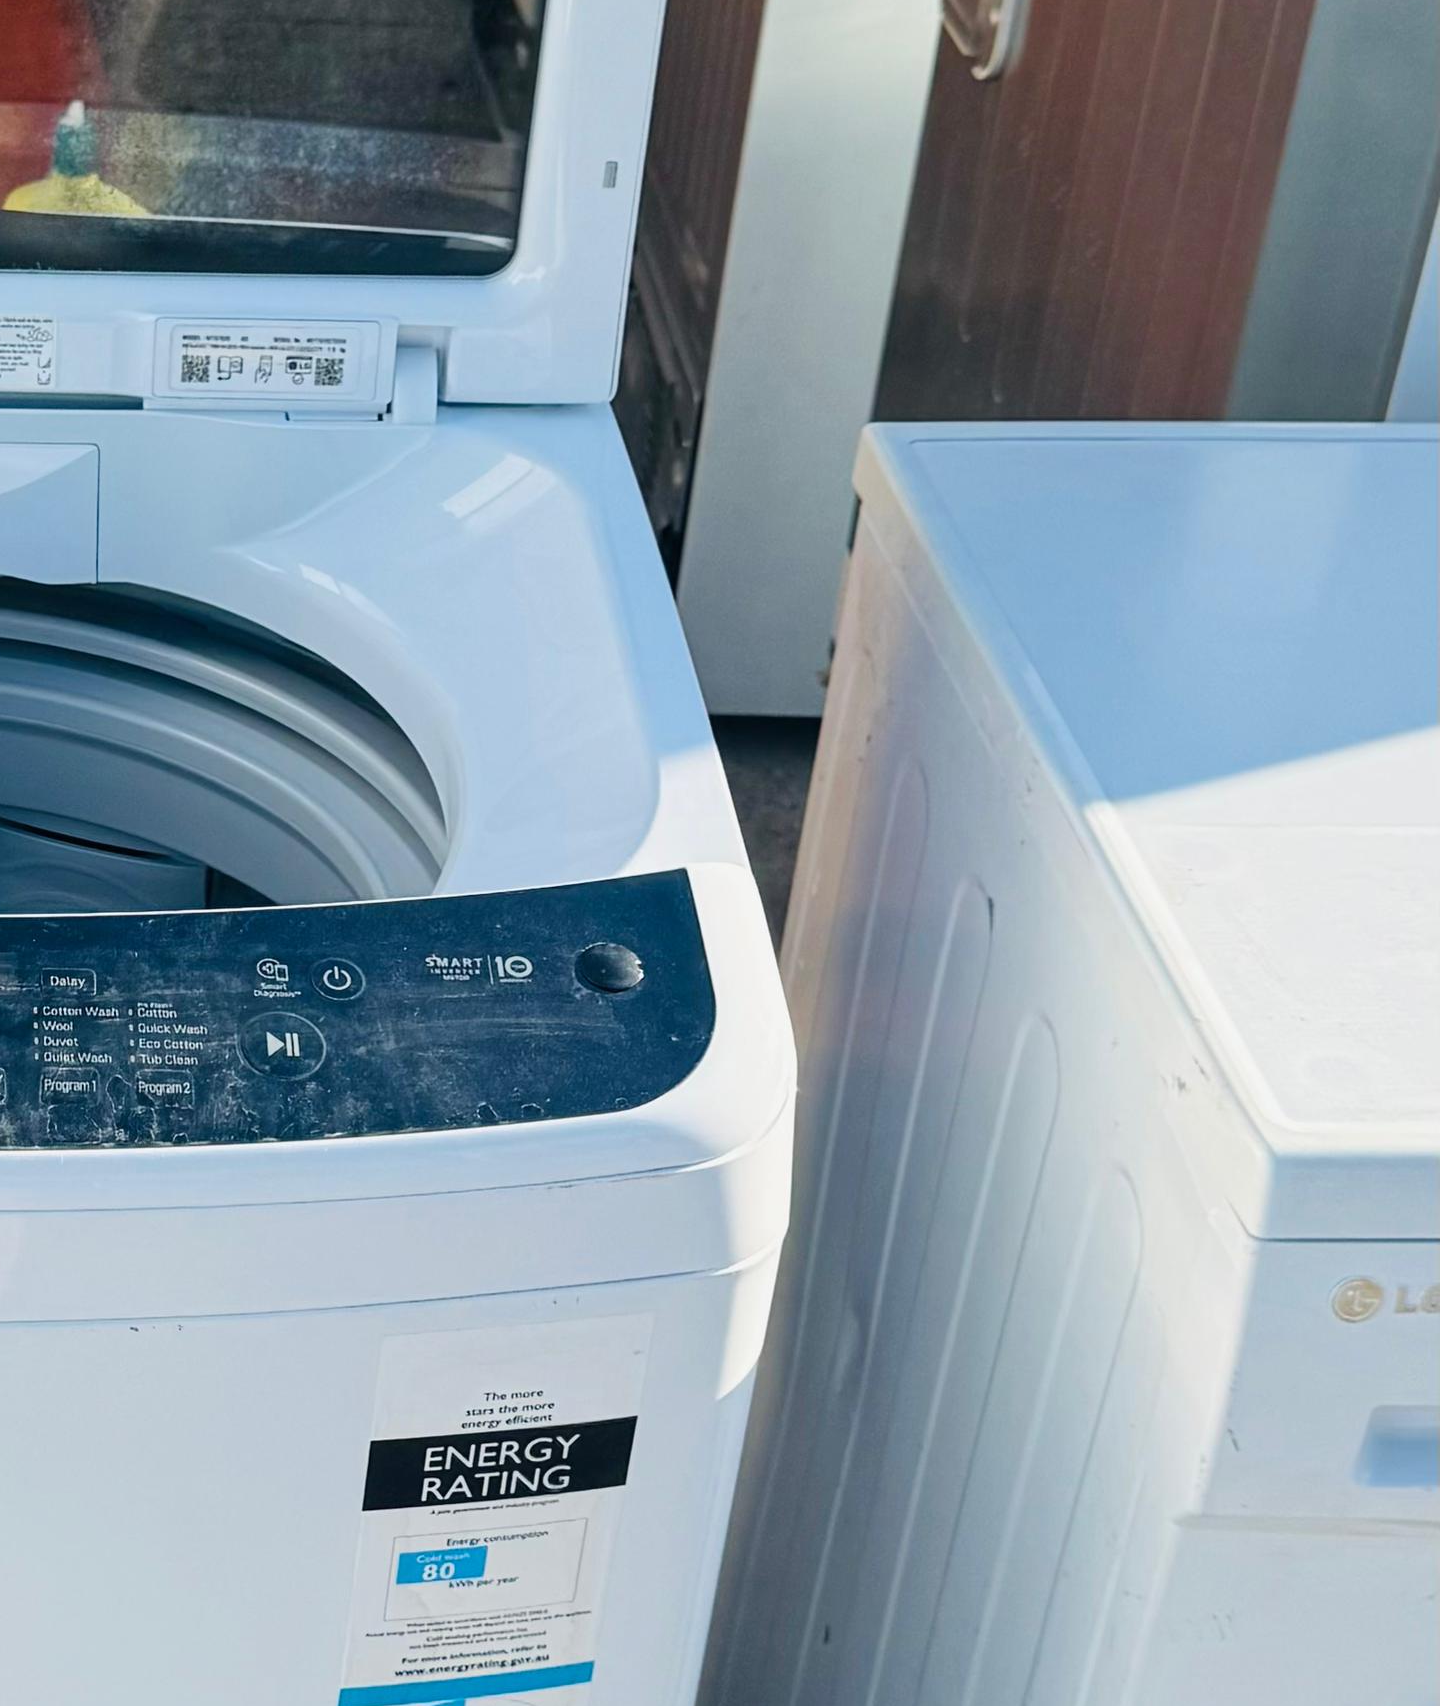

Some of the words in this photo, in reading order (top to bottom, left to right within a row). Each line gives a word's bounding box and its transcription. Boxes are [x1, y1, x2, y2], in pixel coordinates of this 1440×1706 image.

[425, 955, 482, 967] SMART
[50, 975, 85, 989] Delay
[42, 1006, 82, 1016] Cotton
[85, 1006, 119, 1017] Wash
[137, 1008, 177, 1018] Cotton
[42, 1021, 73, 1031] Wool
[138, 1023, 171, 1034] Quick
[174, 1024, 208, 1035] Wash
[43, 1036, 79, 1047] Duvet
[139, 1038, 160, 1049] Eco
[163, 1039, 203, 1050] Cotton
[44, 1052, 75, 1063] Quiet
[78, 1053, 112, 1063] Wash
[140, 1054, 162, 1064] Tub
[165, 1054, 198, 1065] Clean
[44, 1079, 89, 1093] Program
[138, 1081, 181, 1095] Program
[183, 1082, 191, 1093] 2
[484, 1392, 507, 1402] The
[511, 1390, 544, 1400] more
[466, 1408, 494, 1416] stars
[499, 1405, 518, 1414] the
[522, 1402, 555, 1411] more
[461, 1419, 501, 1429] energy
[505, 1414, 552, 1425] efficient
[423, 1433, 581, 1472] ENERGY
[420, 1465, 572, 1502] RATING
[446, 1537, 481, 1547] Energy
[417, 1554, 442, 1563] Cold
[422, 1562, 455, 1581] 80
[477, 1579, 494, 1588] per
[496, 1576, 519, 1586] year
